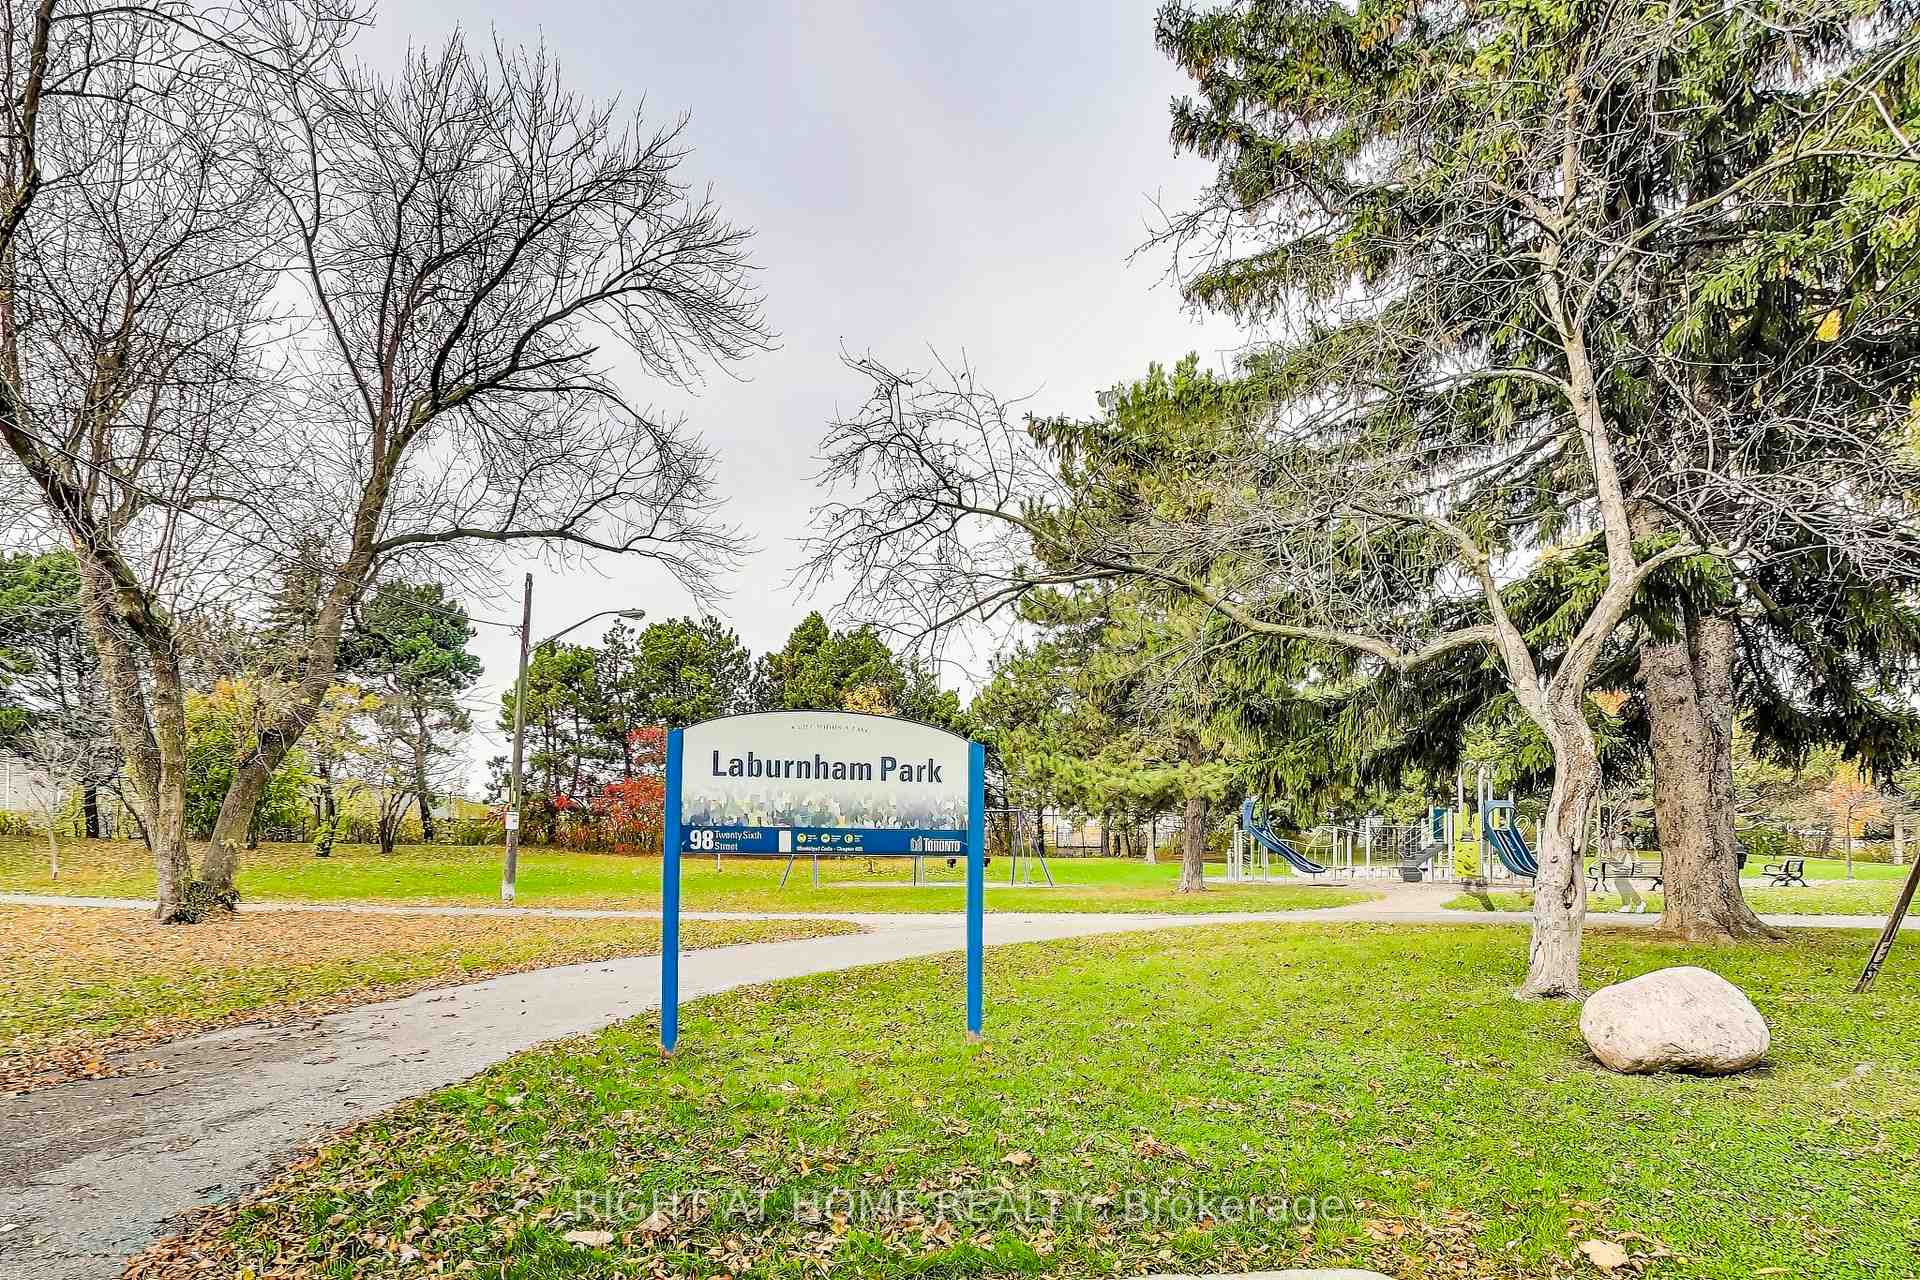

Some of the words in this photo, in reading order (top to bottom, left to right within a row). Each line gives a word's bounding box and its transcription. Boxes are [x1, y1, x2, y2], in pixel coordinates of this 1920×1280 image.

[712, 750, 872, 781] Laburnham
[880, 756, 943, 784] Park
[690, 830, 714, 850] 98
[714, 841, 738, 851] Street
